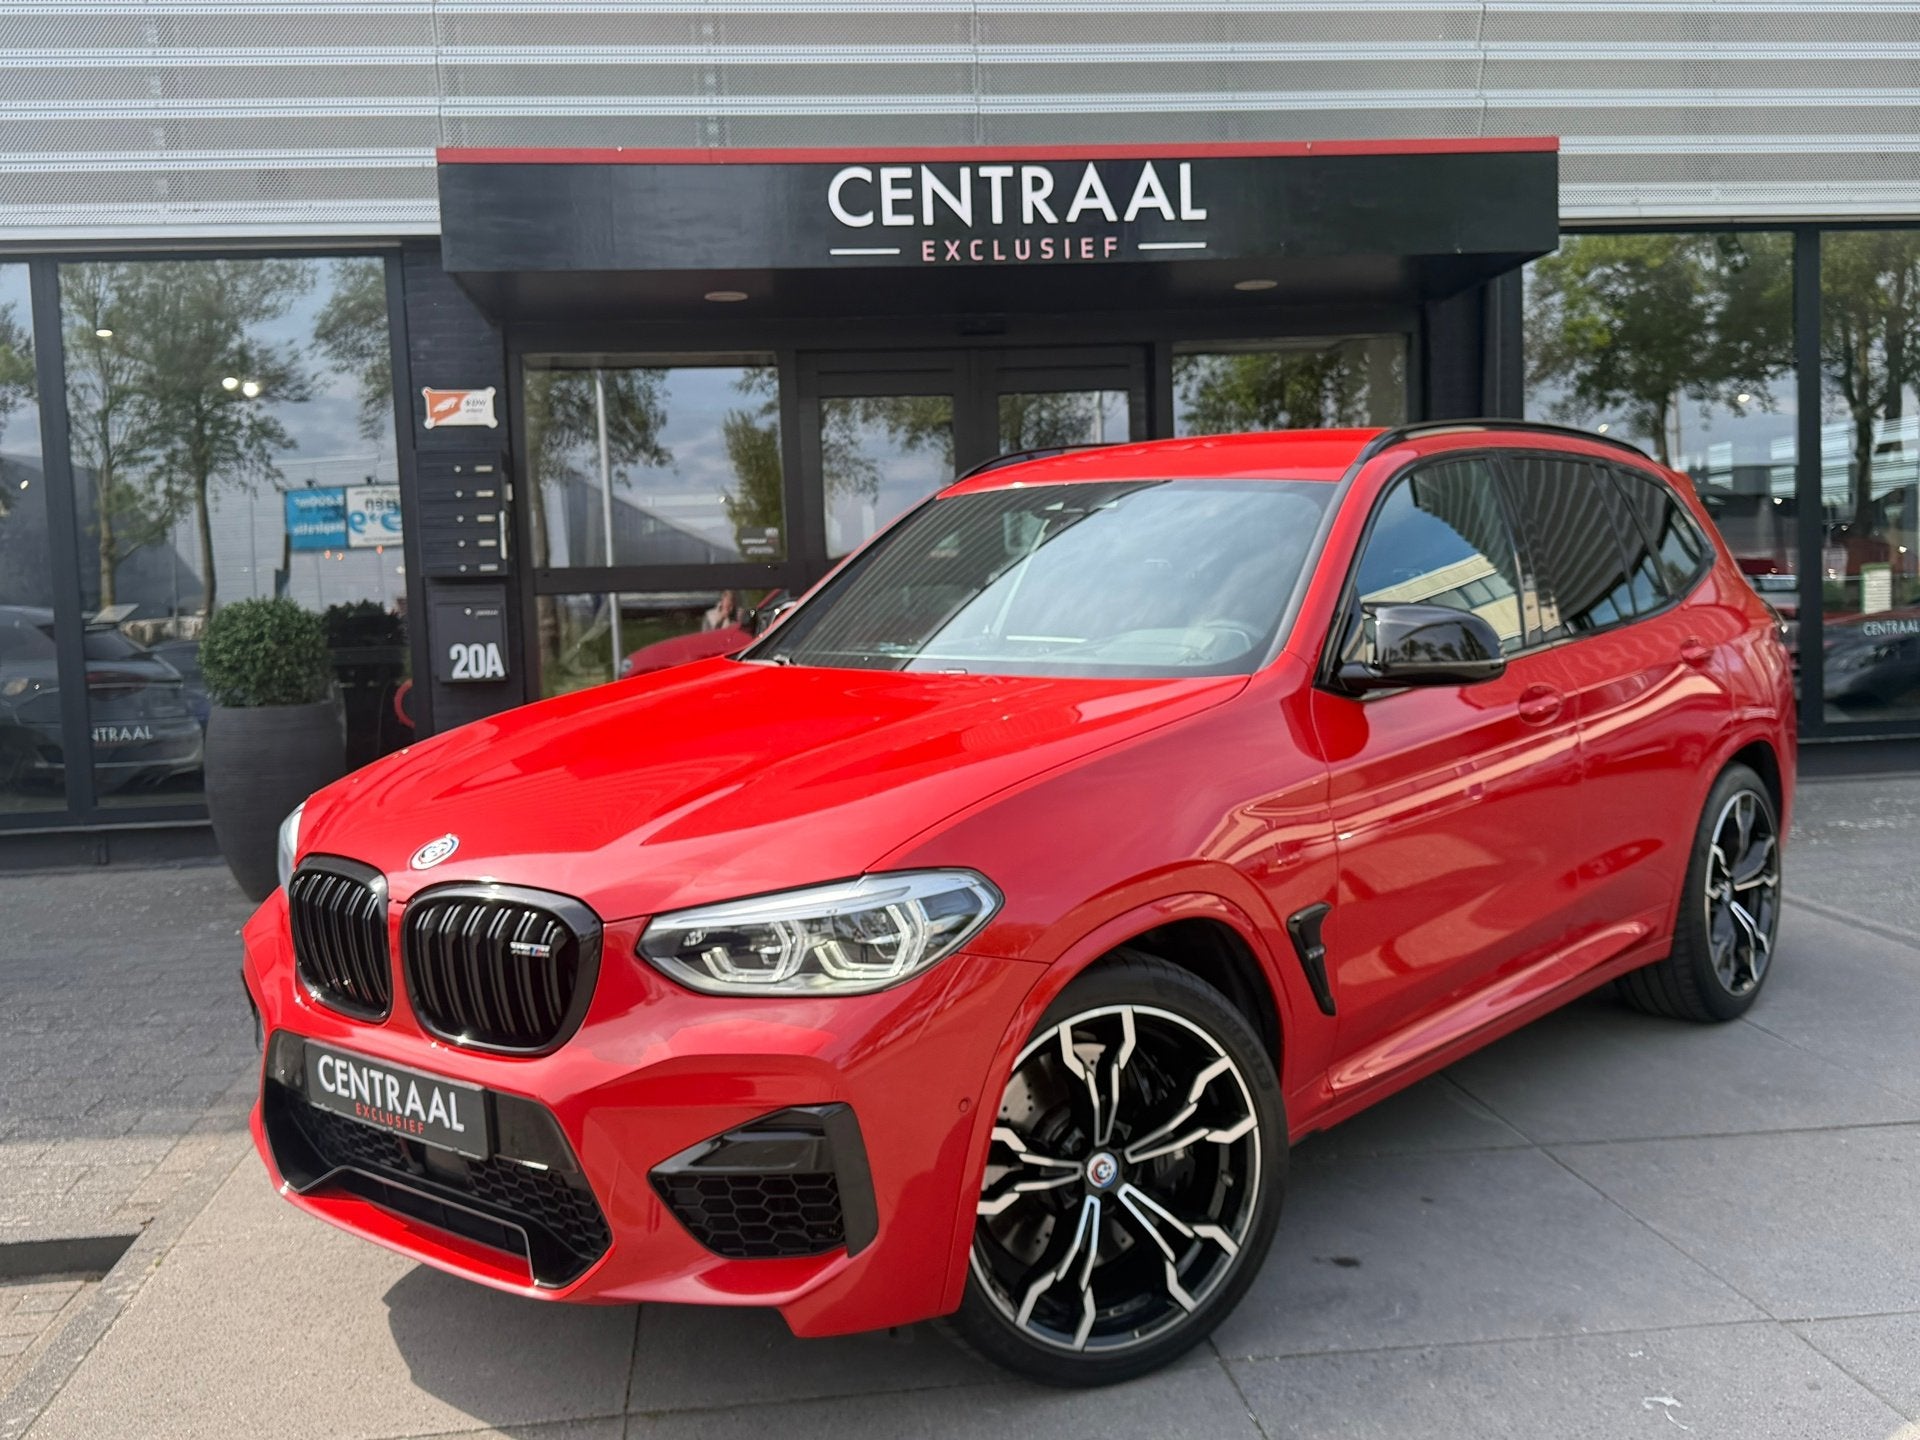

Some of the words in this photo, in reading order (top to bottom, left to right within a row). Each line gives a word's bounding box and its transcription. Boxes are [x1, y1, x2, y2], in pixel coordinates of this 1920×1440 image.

[827, 161, 1208, 228] CENTRAAL
[921, 237, 1119, 262] EXCLUSIEF
[449, 642, 506, 680] 20A
[317, 1054, 465, 1133] CENTRAAL
[355, 1101, 425, 1135] EXCLUSIEF
